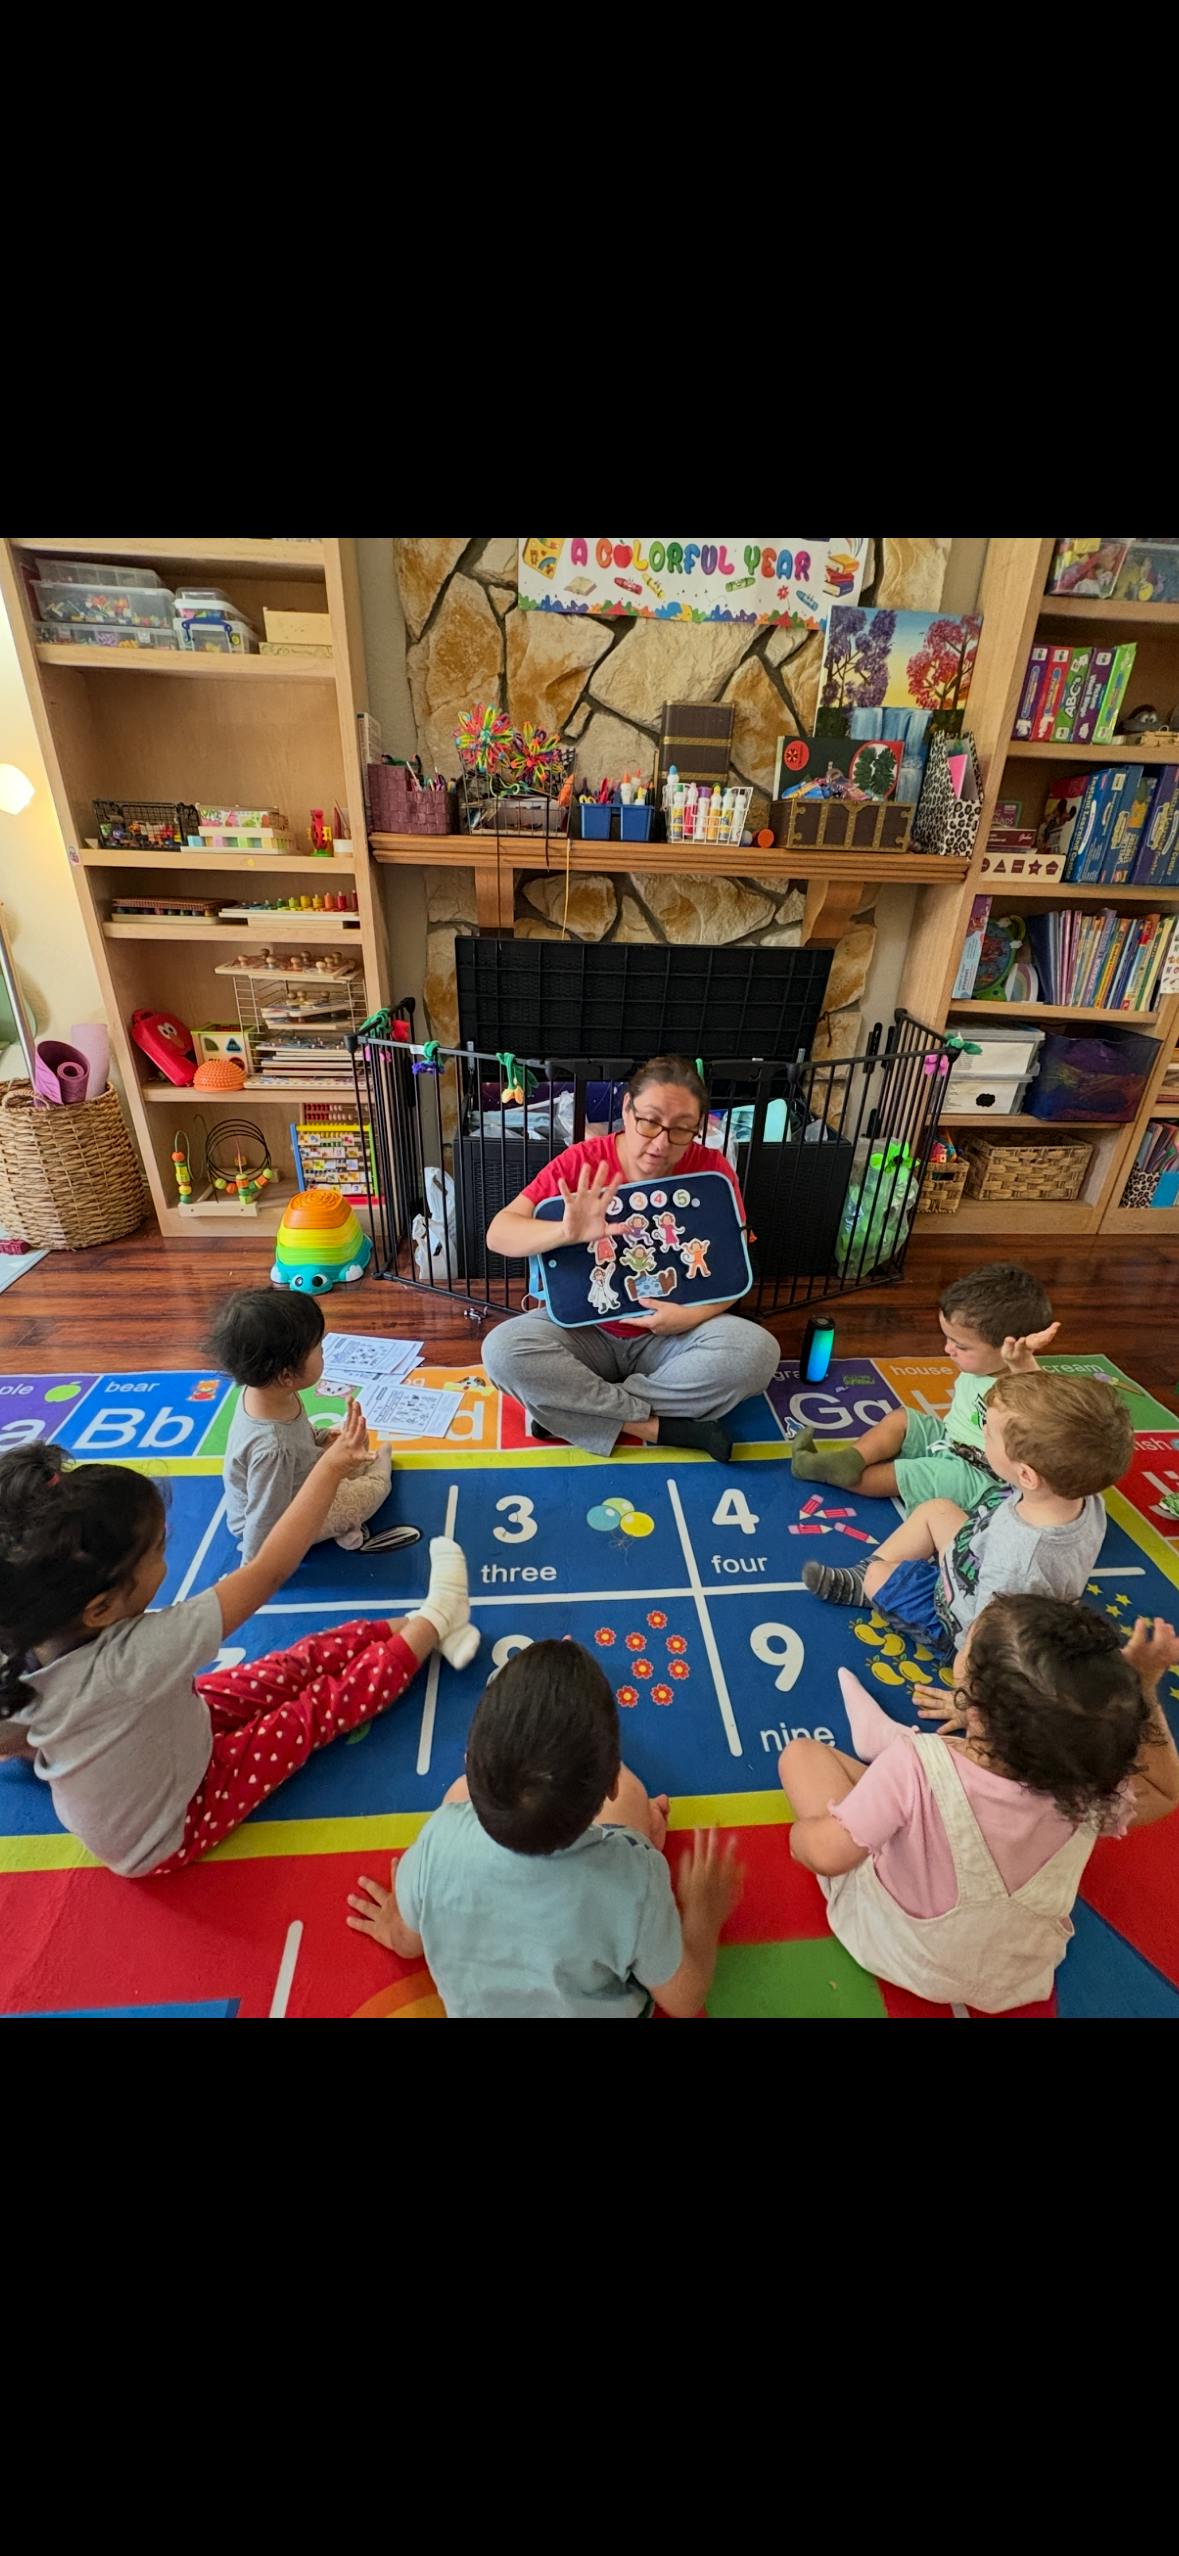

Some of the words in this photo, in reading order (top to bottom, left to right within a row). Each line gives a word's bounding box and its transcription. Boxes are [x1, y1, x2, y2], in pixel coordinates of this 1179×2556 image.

[571, 538, 588, 567] A
[595, 538, 735, 576] COLORFUL
[744, 545, 811, 582] YEAR
[633, 1195, 644, 1208] 3
[677, 1192, 687, 1206] 5
[891, 1365, 954, 1376] house
[1042, 1363, 1105, 1374] cream
[104, 1380, 160, 1394] bear
[71, 1406, 195, 1450] Bb
[1134, 1437, 1173, 1451] ish
[492, 1494, 539, 1544] 3
[711, 1488, 760, 1535] 4
[480, 1563, 558, 1584] three
[711, 1554, 768, 1574] four
[749, 1622, 805, 1692] 9
